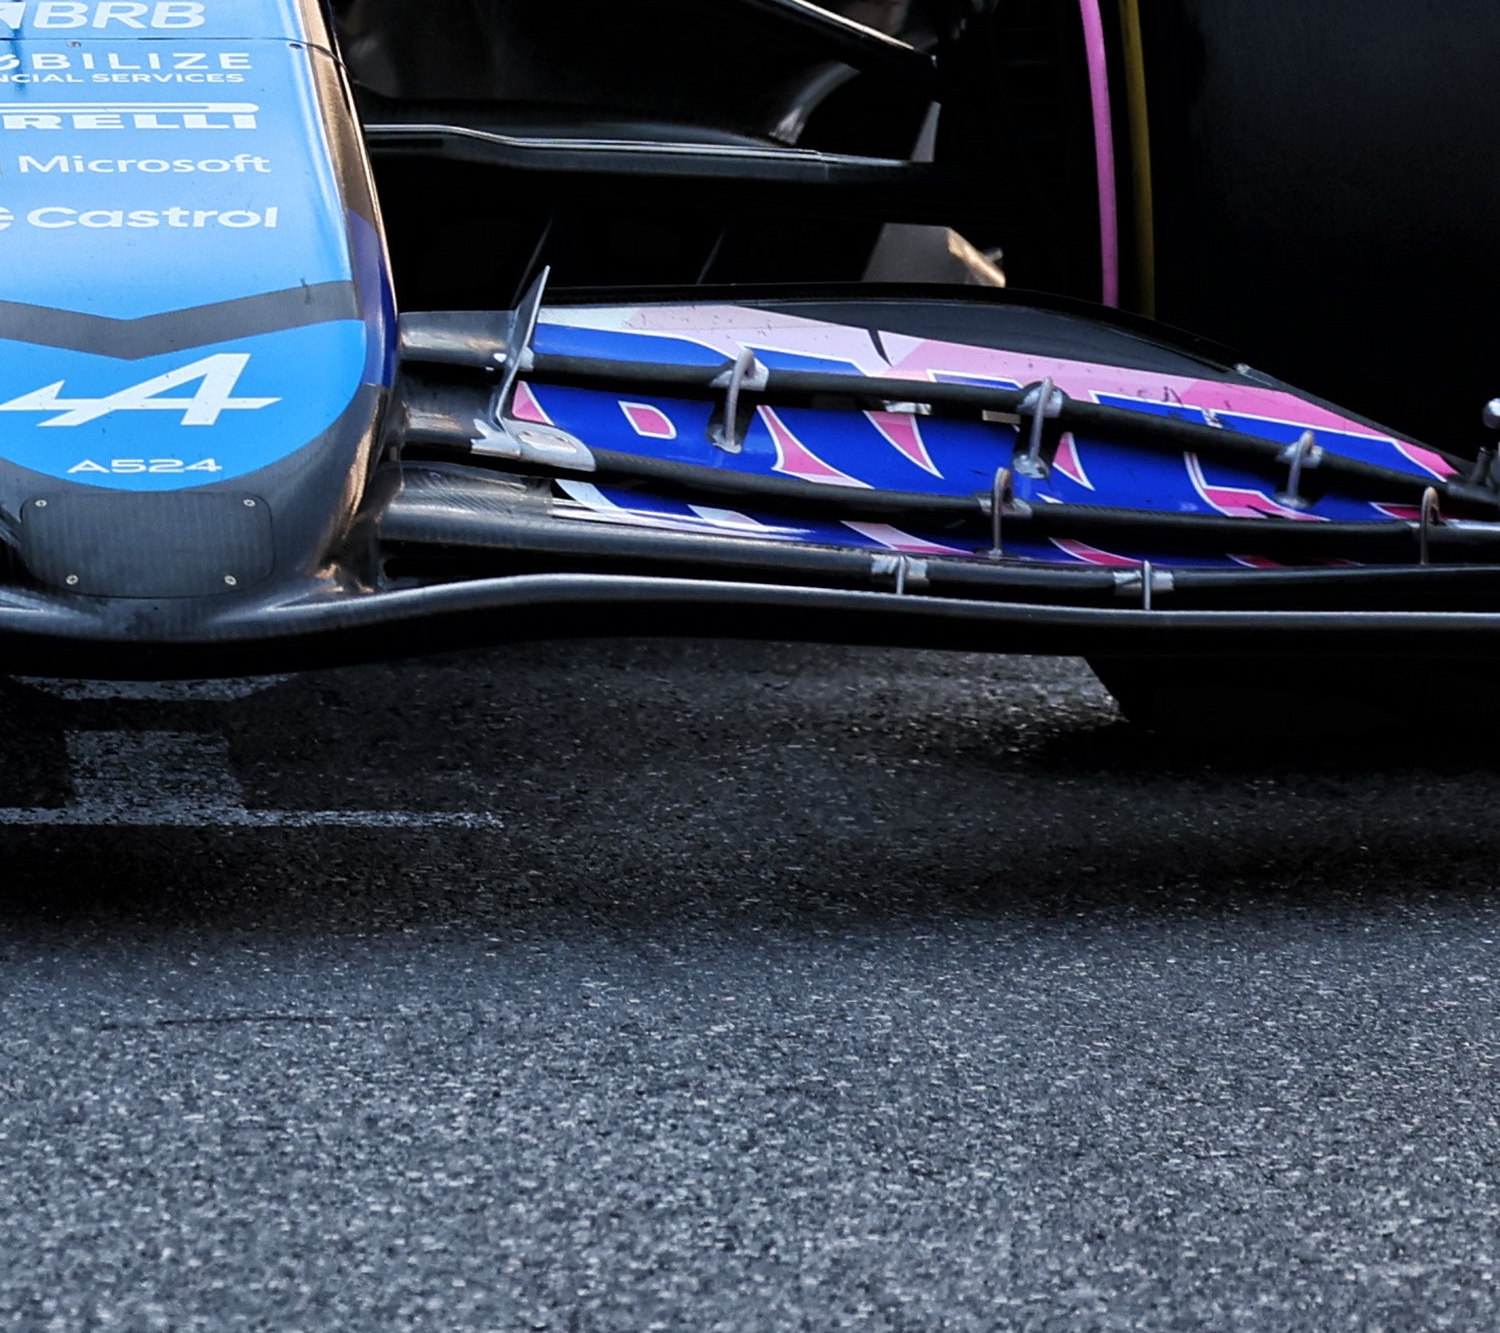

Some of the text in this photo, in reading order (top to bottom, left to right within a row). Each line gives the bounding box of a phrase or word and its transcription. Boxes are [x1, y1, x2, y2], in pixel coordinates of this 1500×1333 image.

[32, 1, 206, 30] BRB
[92, 72, 246, 84] SERVICES
[17, 153, 273, 174] Microsoft
[26, 205, 279, 229] Castrol
[66, 457, 224, 474] A524
